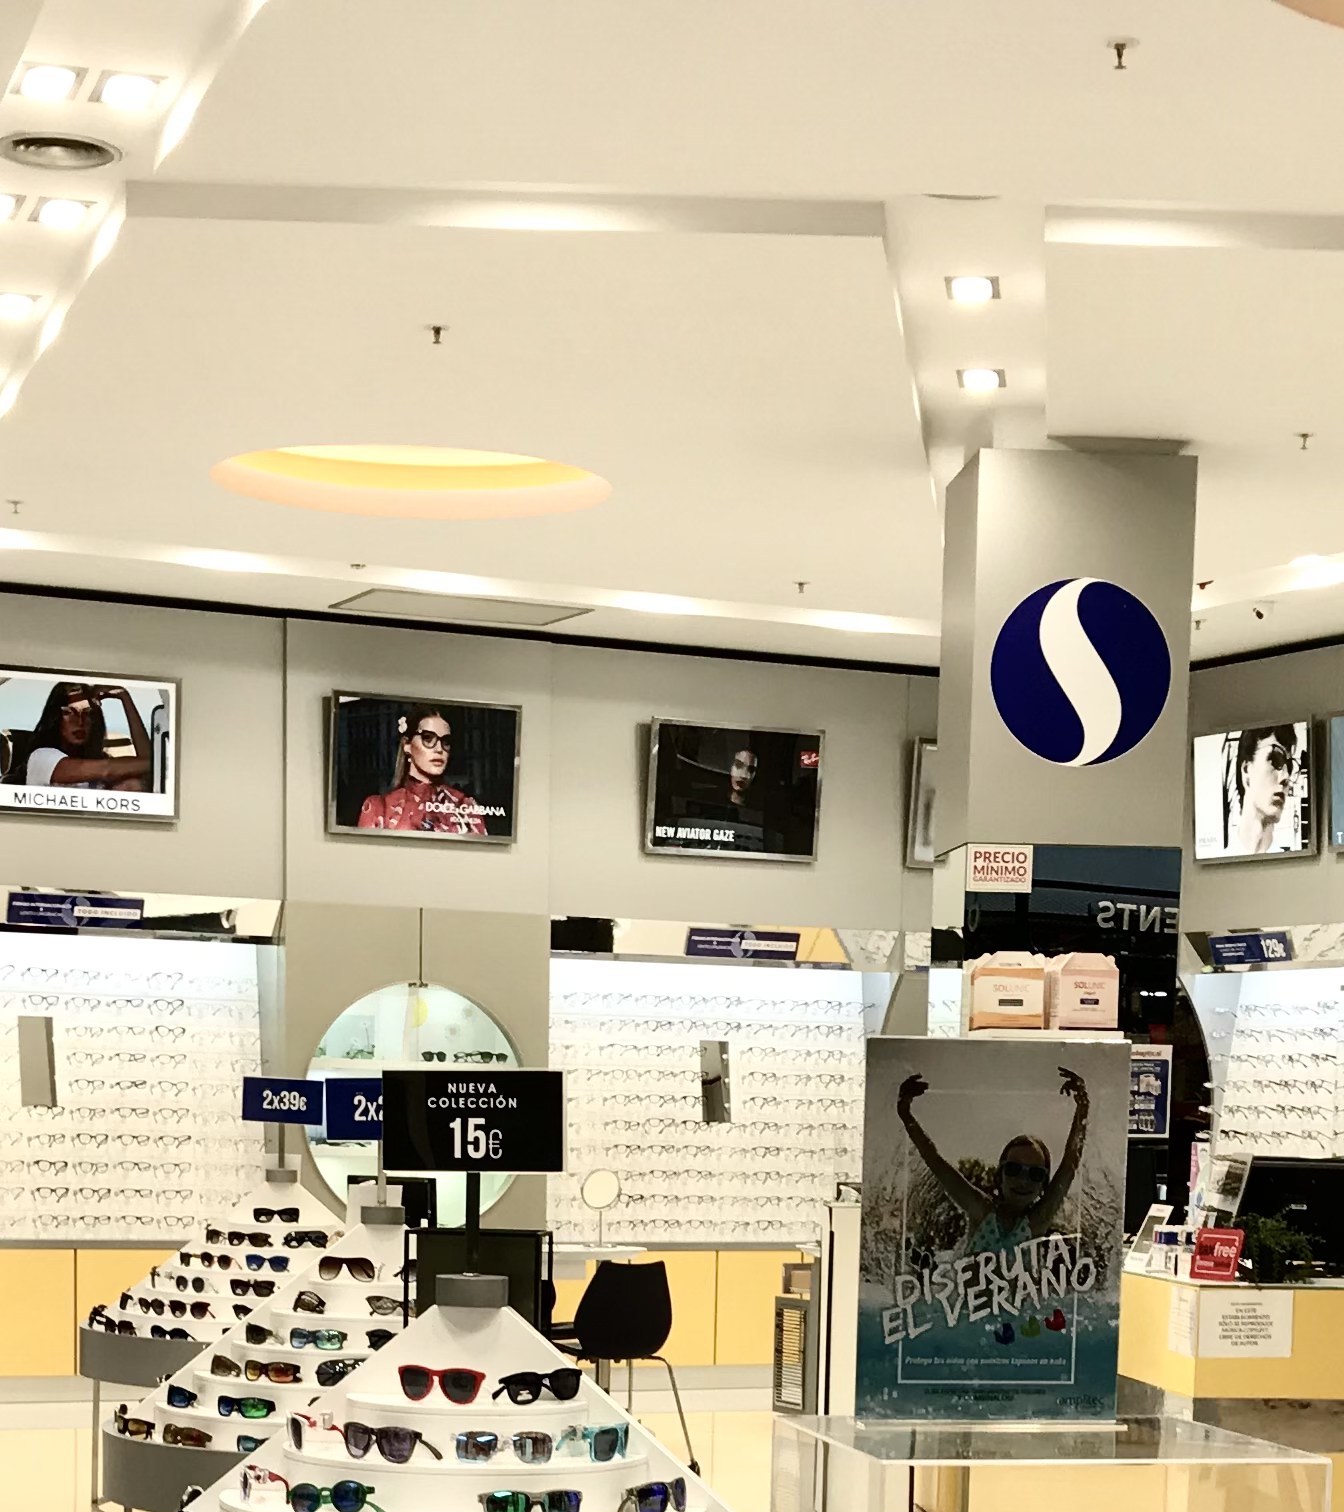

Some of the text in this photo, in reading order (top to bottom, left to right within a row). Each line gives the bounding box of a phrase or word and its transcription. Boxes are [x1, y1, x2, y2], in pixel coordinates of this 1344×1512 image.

[14, 792, 141, 812] MICHAEL KORS
[656, 826, 734, 842] NEW AVIATOR GAZE
[974, 851, 1027, 864] PRECIO
[973, 863, 1027, 876] MÍNIMO
[448, 1083, 497, 1094] NUEVA
[262, 1089, 307, 1111] 2x39€
[427, 1094, 518, 1109] COLECCIÓN
[449, 1117, 503, 1159] 15€
[895, 1232, 1082, 1307] DISFRUTA
[883, 1257, 1097, 1344] EL VERANO
